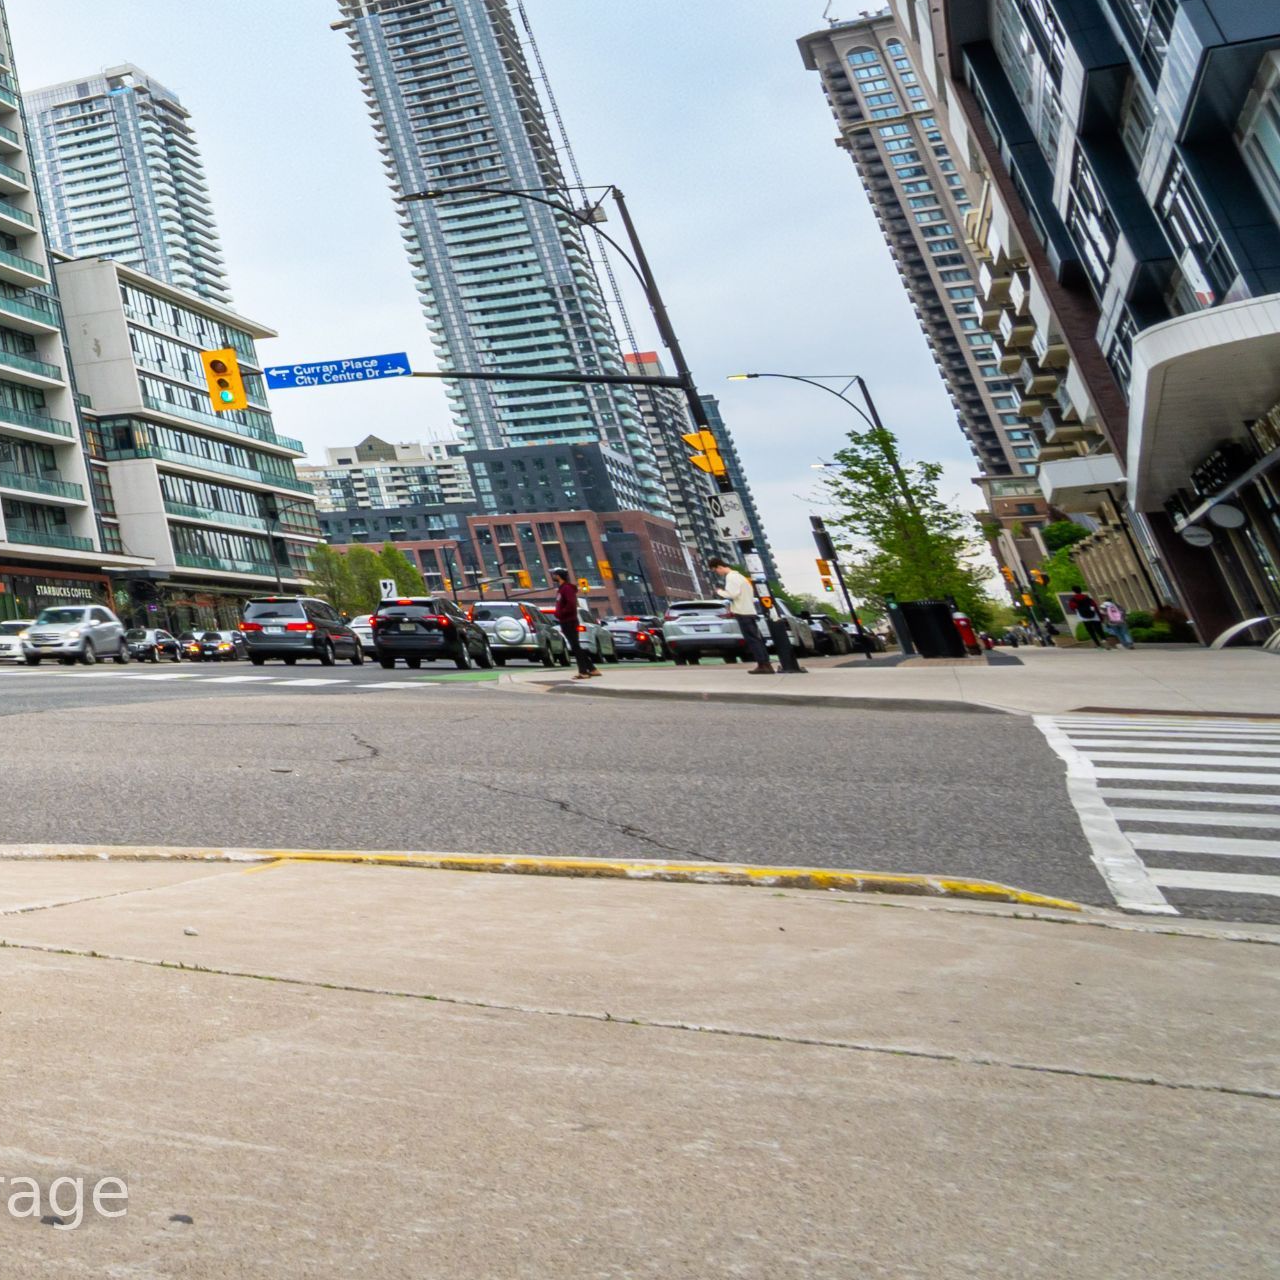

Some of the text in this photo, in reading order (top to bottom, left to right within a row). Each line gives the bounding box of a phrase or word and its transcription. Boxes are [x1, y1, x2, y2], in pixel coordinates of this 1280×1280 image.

[293, 359, 378, 376] Curran Place
[295, 368, 380, 386] City Centre Dr
[36, 585, 92, 599] STARBUCKS COFFEE
